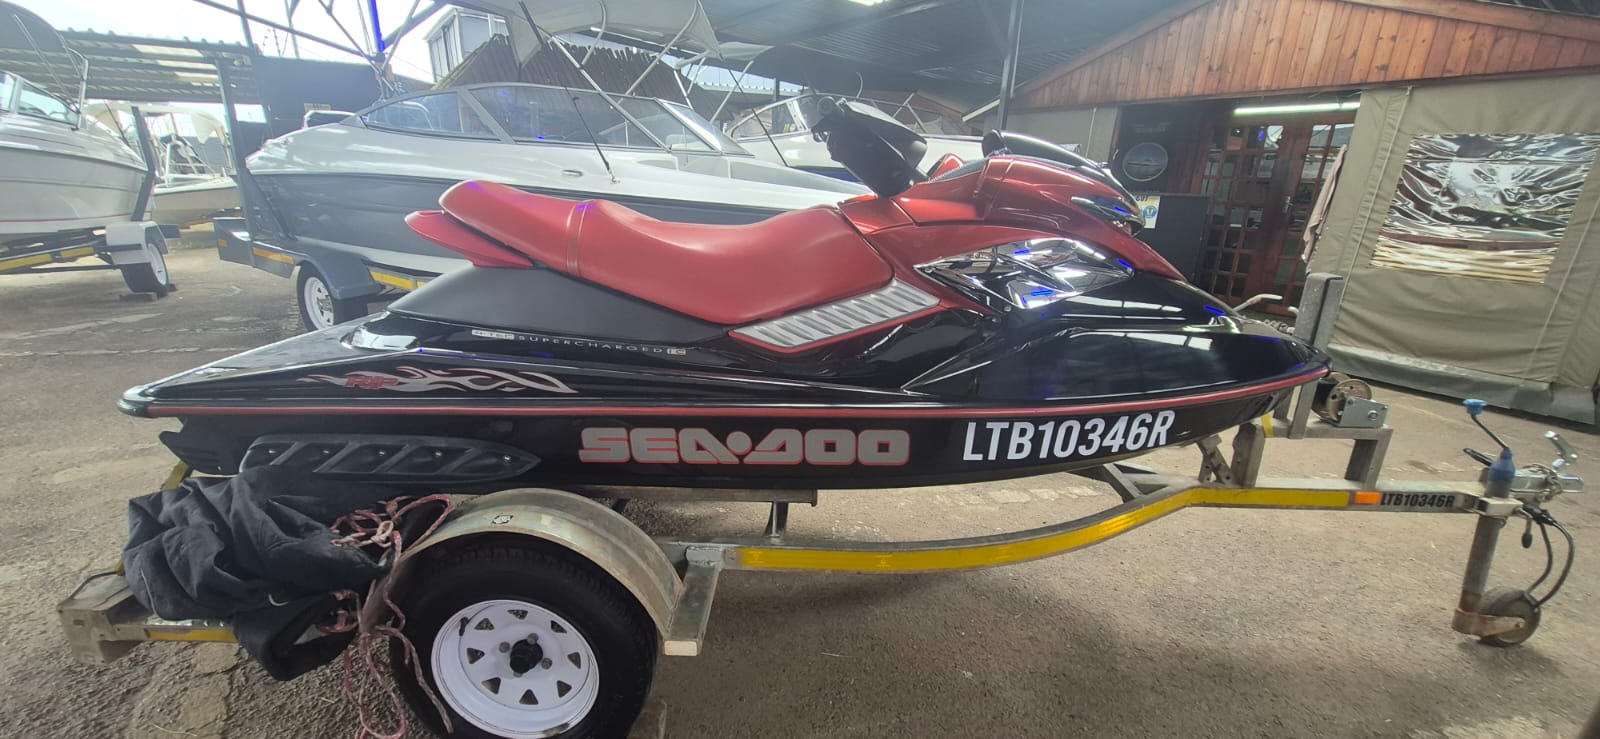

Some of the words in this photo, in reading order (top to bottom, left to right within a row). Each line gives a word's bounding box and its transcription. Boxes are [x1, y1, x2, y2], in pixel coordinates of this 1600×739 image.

[518, 335, 662, 353] SUPERCHARGED
[962, 410, 1175, 461] LTB10346R
[1381, 493, 1456, 508] LTB10346R
